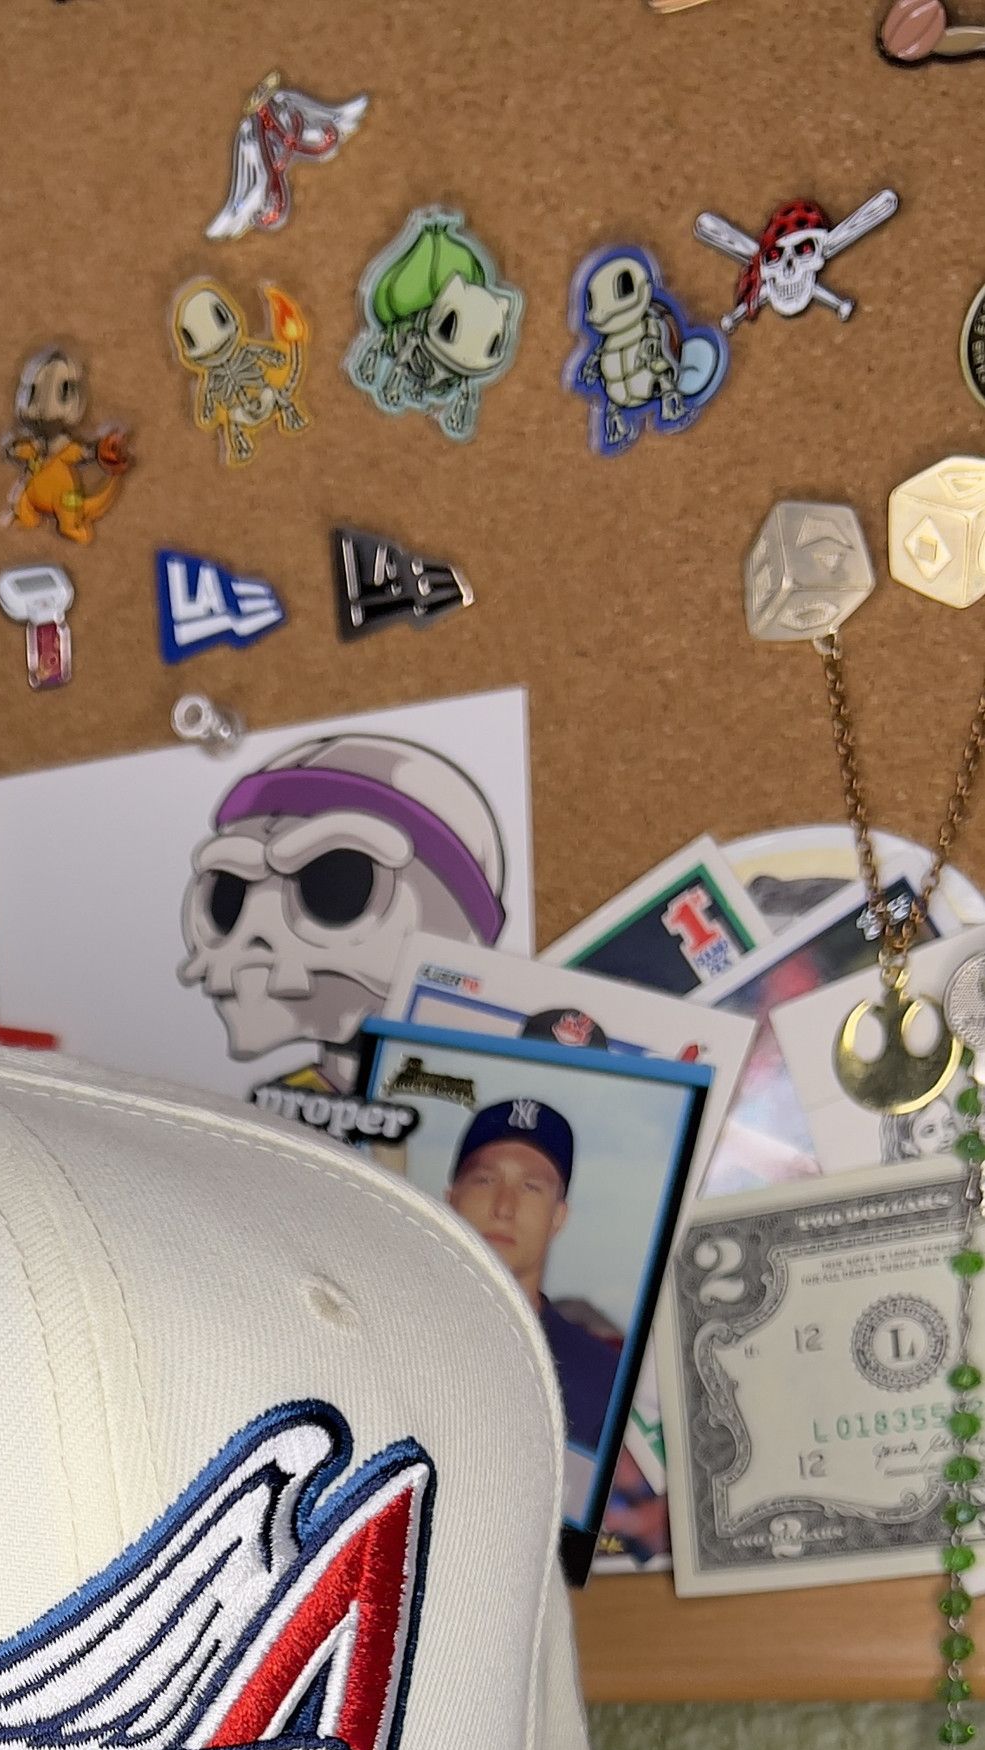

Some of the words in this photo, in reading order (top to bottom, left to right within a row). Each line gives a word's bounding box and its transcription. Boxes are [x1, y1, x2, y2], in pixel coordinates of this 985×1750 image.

[255, 1087, 414, 1138] proper
[694, 1238, 745, 1306] 2
[794, 1323, 824, 1353] 12
[888, 1321, 916, 1362] L
[813, 1399, 984, 1443] L018355
[798, 1451, 828, 1481] 12
